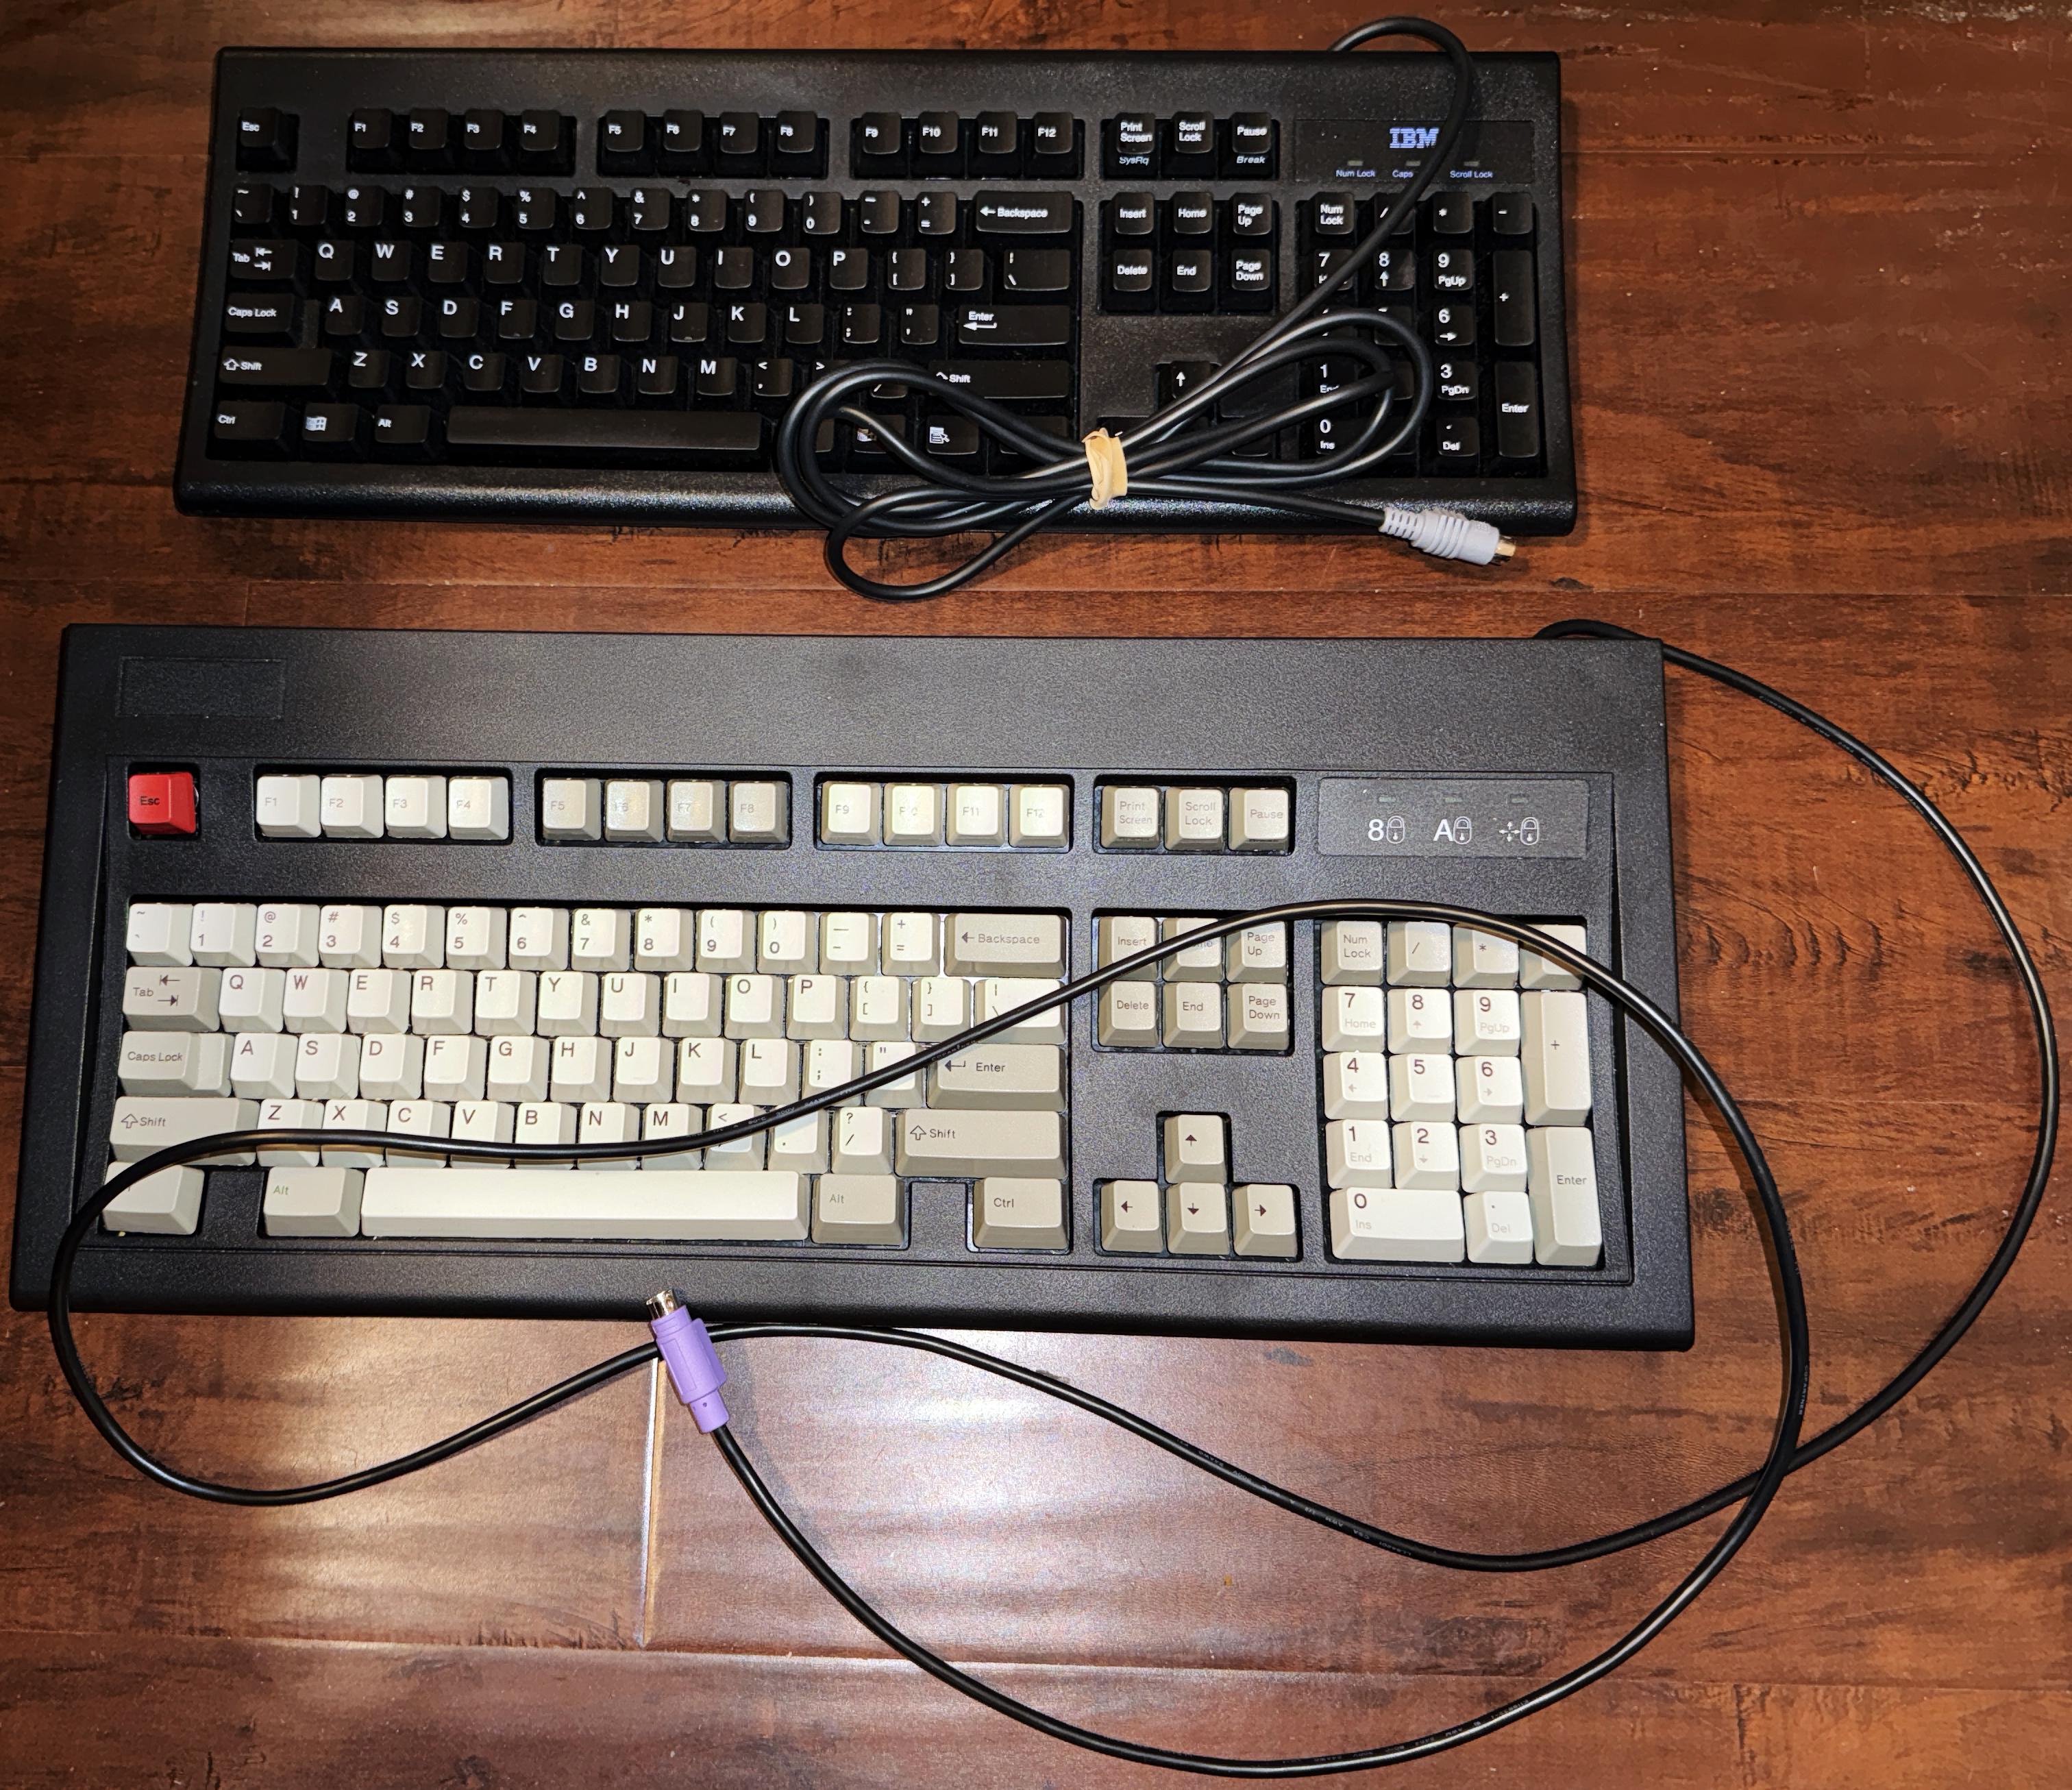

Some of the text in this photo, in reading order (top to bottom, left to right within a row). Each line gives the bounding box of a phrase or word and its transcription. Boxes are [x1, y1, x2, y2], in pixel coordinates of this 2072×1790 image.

[243, 122, 259, 132] Esc
[355, 123, 366, 132] F1
[411, 123, 423, 132] F2
[467, 124, 480, 133] F3
[524, 125, 536, 134] F4
[608, 125, 621, 134] F5
[667, 124, 679, 134] F6
[723, 126, 735, 136] F7
[780, 126, 793, 136] F8
[982, 127, 998, 136] F11
[1121, 122, 1142, 132] Print
[1179, 121, 1205, 131] Scroll
[1237, 126, 1267, 136] Pause
[866, 127, 878, 137] F9
[923, 127, 941, 137] F10
[1038, 127, 1056, 137] F12
[1120, 133, 1152, 142] Screen
[1179, 132, 1201, 141] Lock
[1390, 129, 1438, 148] IBM
[1120, 156, 1149, 165] SysRq
[1392, 170, 1413, 178] Caps
[998, 207, 1048, 219] Backspace
[1120, 209, 1146, 218] Insert
[1179, 208, 1207, 218] Home
[1238, 205, 1263, 217] Page
[1321, 204, 1343, 214] Num
[1238, 216, 1252, 227] Up
[1320, 215, 1343, 225] Lock
[319, 244, 334, 258] Q
[432, 245, 444, 260] E
[547, 247, 559, 262] T
[233, 253, 249, 262] Tab
[661, 249, 674, 265] U
[776, 251, 791, 266] O
[1319, 253, 1330, 267] 7
[1379, 252, 1390, 267] 8
[1438, 253, 1449, 267] 9
[1118, 265, 1148, 275] Delete
[1177, 266, 1196, 275] End
[1236, 260, 1261, 272] Page
[1236, 271, 1263, 280] Down
[1439, 275, 1466, 286] PgUp
[330, 298, 343, 312] A
[444, 300, 457, 315] D
[560, 303, 574, 318] G
[228, 307, 253, 318] Caps
[674, 306, 684, 320] J
[789, 307, 800, 321] L
[969, 311, 994, 321] Enter
[1439, 308, 1450, 323] 6
[354, 352, 367, 367] Z
[469, 355, 483, 369] C
[584, 358, 597, 371] B
[241, 362, 262, 370] Shift
[701, 360, 716, 374] M
[1320, 365, 1327, 378] 1
[1441, 364, 1452, 378] 3
[949, 374, 970, 382] Shift
[1442, 385, 1469, 395] PgDn
[1502, 404, 1529, 413] Enter
[218, 415, 235, 424] Ctrl
[378, 419, 391, 428] Alt
[1320, 419, 1331, 433] 0
[1320, 441, 1335, 449] Ins
[1443, 441, 1459, 450] Del
[140, 796, 160, 806] Esc
[264, 797, 277, 807] F1
[329, 798, 344, 808] F2
[393, 798, 408, 809] F3
[456, 800, 471, 809] F4
[550, 800, 565, 811] F5
[1120, 800, 1145, 811] Print
[1185, 801, 1216, 811] Scroll
[835, 804, 850, 815] F9
[963, 806, 979, 816] F11
[1250, 809, 1283, 819] Pause
[1119, 814, 1152, 824] Screen
[1185, 815, 1212, 826] Lock
[1368, 819, 1384, 841] 8
[1433, 819, 1453, 841] A
[978, 933, 1040, 945] Backspace
[1118, 936, 1146, 946] Insert
[1247, 931, 1276, 944] Page
[1343, 934, 1368, 944] Num
[1247, 946, 1262, 957] Up
[1344, 948, 1370, 958] Lock
[229, 974, 244, 990] Q
[293, 974, 308, 990] W
[420, 975, 434, 991] R
[548, 977, 561, 992] Y
[800, 979, 813, 994] P
[132, 987, 154, 997] Tab
[1116, 1000, 1149, 1010] Delete
[1248, 995, 1276, 1008] Page
[1344, 992, 1356, 1008] 7
[1411, 994, 1424, 1010] 8
[1479, 996, 1491, 1012] 9
[1183, 1001, 1203, 1012] End
[1248, 1009, 1280, 1020] Down
[1344, 1018, 1377, 1029] Home
[1479, 1022, 1509, 1035] PgUp
[240, 1040, 254, 1055] A
[305, 1040, 319, 1055] S
[433, 1040, 445, 1056] F
[560, 1042, 575, 1057] H
[688, 1042, 702, 1058] K
[752, 1044, 762, 1059] L
[127, 1051, 183, 1062] Caps Lock
[976, 1062, 1005, 1072] Enter
[1346, 1057, 1359, 1073] 4
[1414, 1059, 1425, 1075] 5
[1481, 1061, 1493, 1077] 6
[332, 1105, 347, 1121] X
[463, 1109, 476, 1125] V
[525, 1109, 538, 1125] B
[589, 1110, 602, 1126] N
[653, 1110, 669, 1126] M
[139, 1116, 166, 1127] Shift
[929, 1129, 956, 1139] Shift
[1348, 1126, 1356, 1142] 1
[1416, 1128, 1429, 1144] 2
[1485, 1129, 1497, 1146] 3
[1350, 1151, 1372, 1163] End
[1486, 1155, 1516, 1168] PgDn
[1556, 1175, 1587, 1186] Enter
[273, 1185, 289, 1195] Alt
[829, 1194, 844, 1204] Alt
[994, 1197, 1014, 1208] Ctrl
[1354, 1193, 1367, 1209] 0
[1355, 1219, 1372, 1230] Ins
[1491, 1223, 1511, 1234] Del
